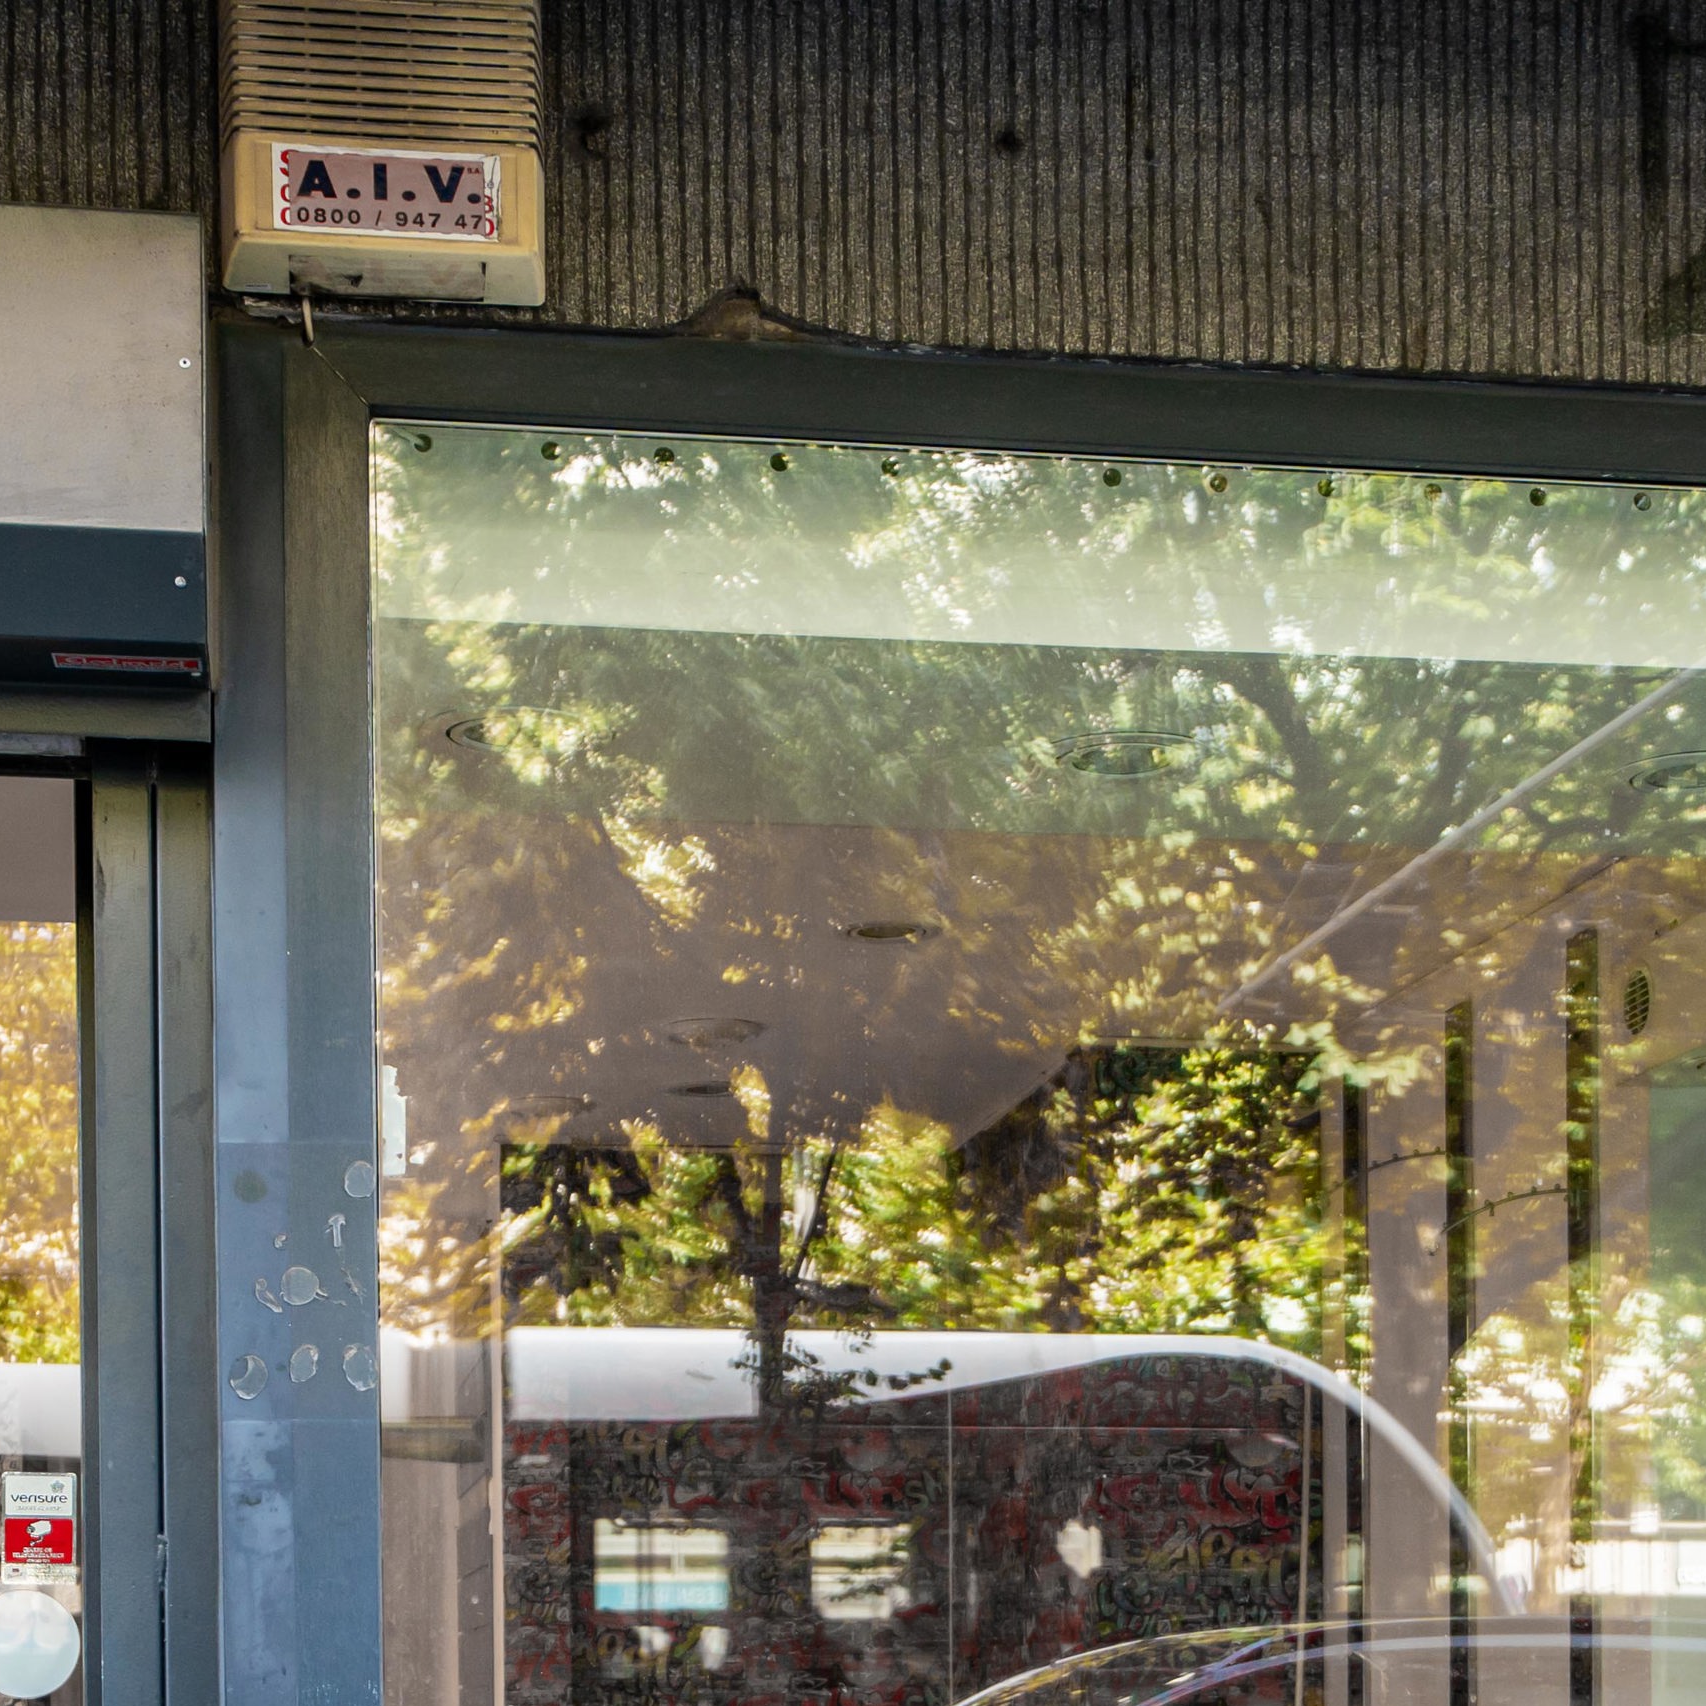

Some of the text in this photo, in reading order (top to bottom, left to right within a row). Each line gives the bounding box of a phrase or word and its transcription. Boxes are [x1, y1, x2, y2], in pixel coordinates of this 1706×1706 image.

[297, 159, 482, 204] A.I.V.
[297, 207, 361, 225] 0800
[396, 212, 441, 228] 947
[455, 214, 482, 230] 47
[11, 1493, 68, 1504] verisure
